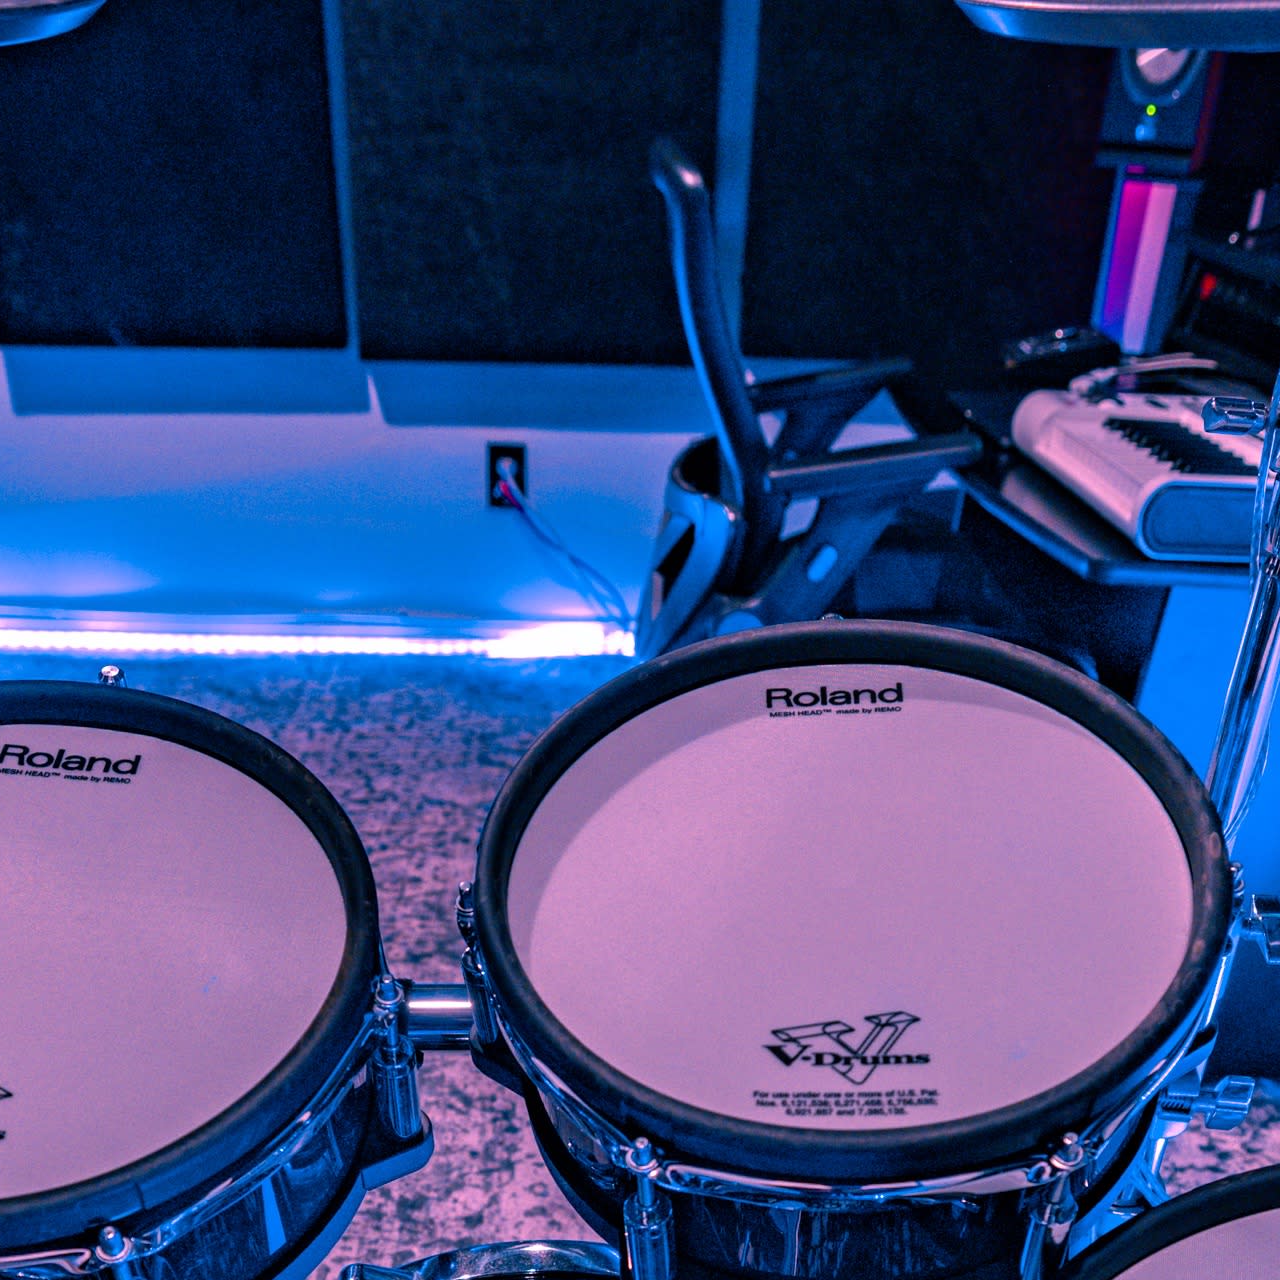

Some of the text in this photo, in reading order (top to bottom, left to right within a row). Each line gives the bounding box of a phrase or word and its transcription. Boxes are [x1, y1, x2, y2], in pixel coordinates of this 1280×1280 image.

[766, 682, 904, 709] Roland
[90, 775, 101, 783] by
[103, 776, 131, 784] REMO
[762, 1044, 931, 1067] V-Drums
[753, 1090, 769, 1098] For
